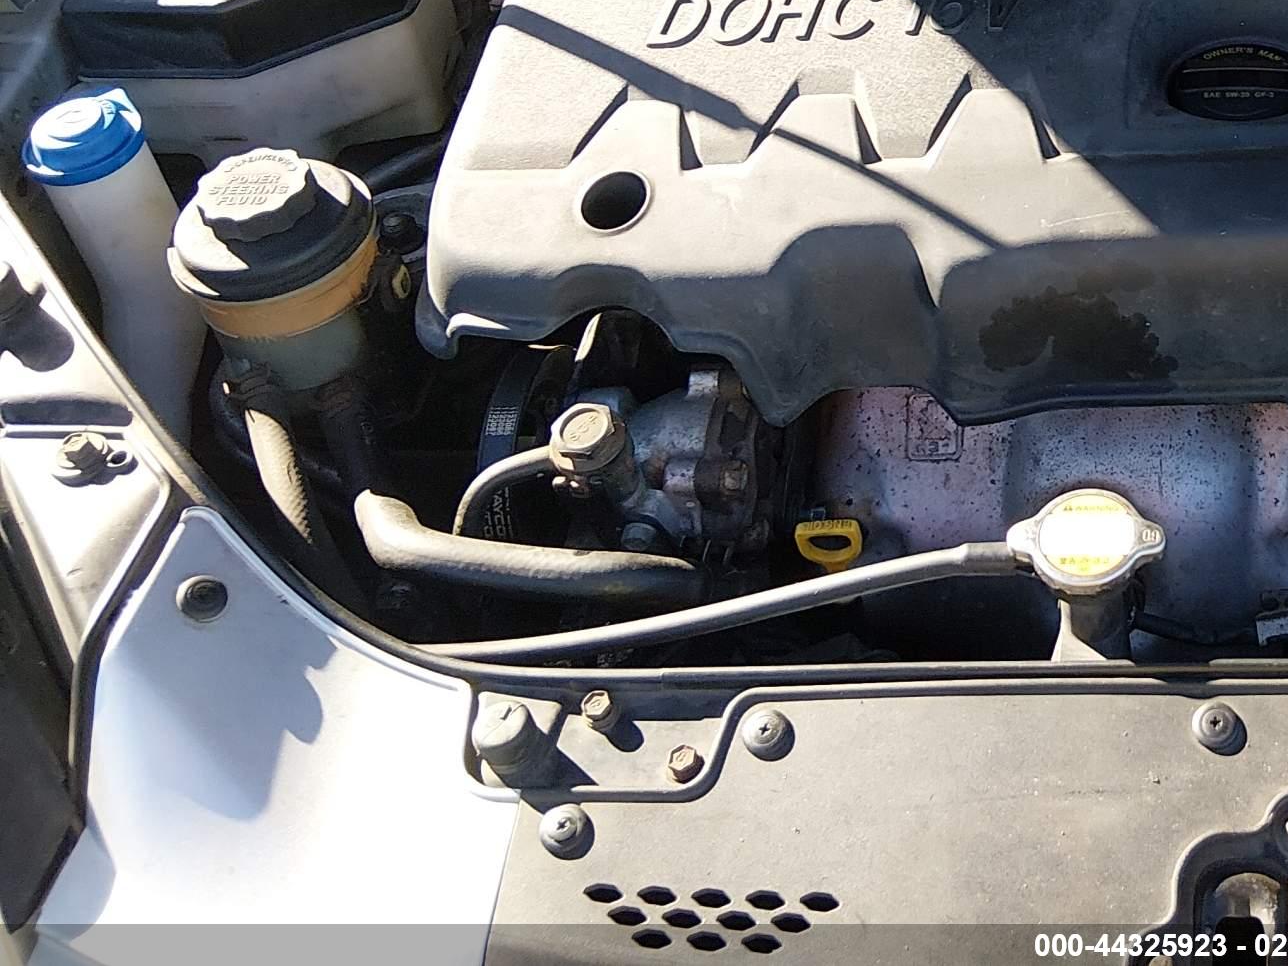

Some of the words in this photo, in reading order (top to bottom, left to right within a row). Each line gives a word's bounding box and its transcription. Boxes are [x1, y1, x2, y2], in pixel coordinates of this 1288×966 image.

[1203, 46, 1254, 60] OWNER'S
[228, 174, 280, 185] POWER
[208, 185, 289, 196] STEERING
[216, 195, 268, 206] FLUID
